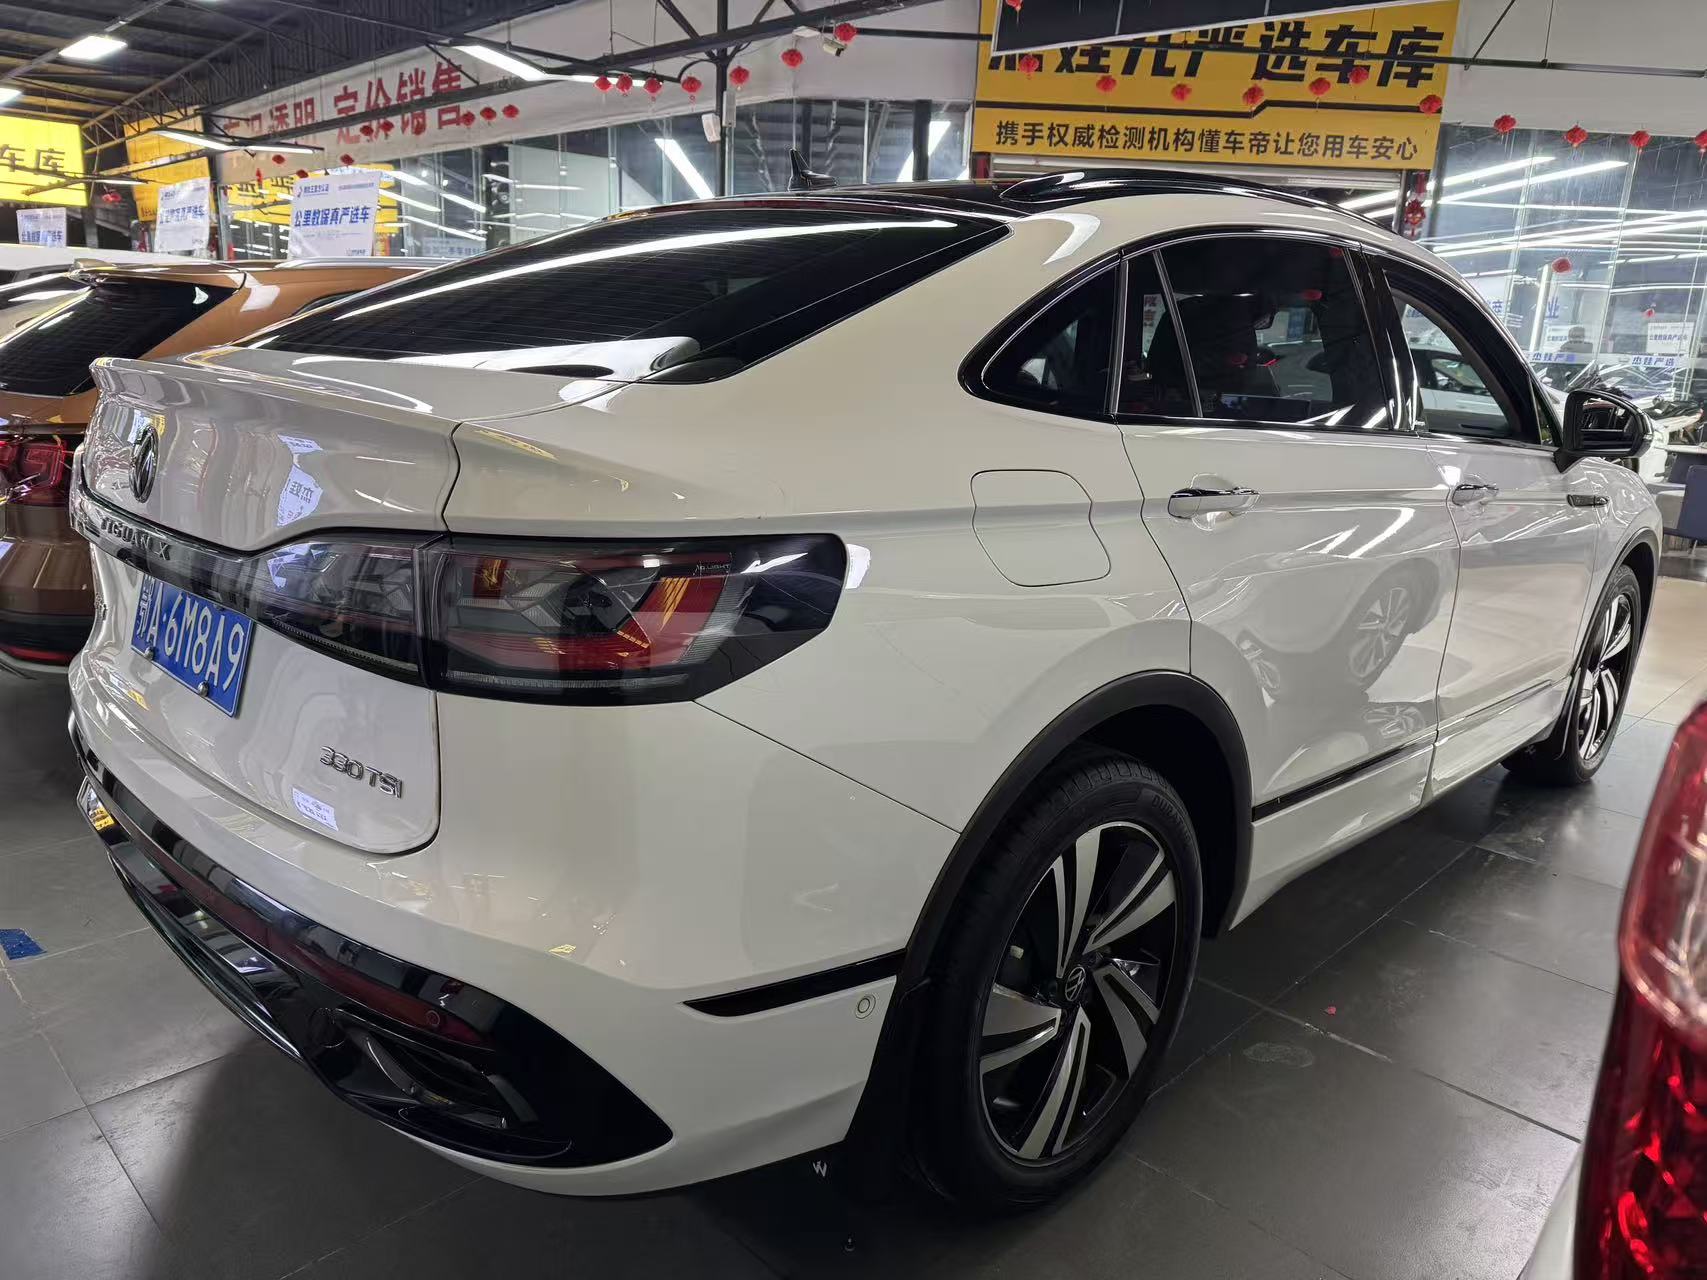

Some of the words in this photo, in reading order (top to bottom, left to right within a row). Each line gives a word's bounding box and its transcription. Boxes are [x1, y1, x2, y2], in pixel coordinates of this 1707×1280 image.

[334, 58, 462, 144] 定价销售
[996, 120, 1418, 161] 携手权威检测机构懂车帝让您用车安心
